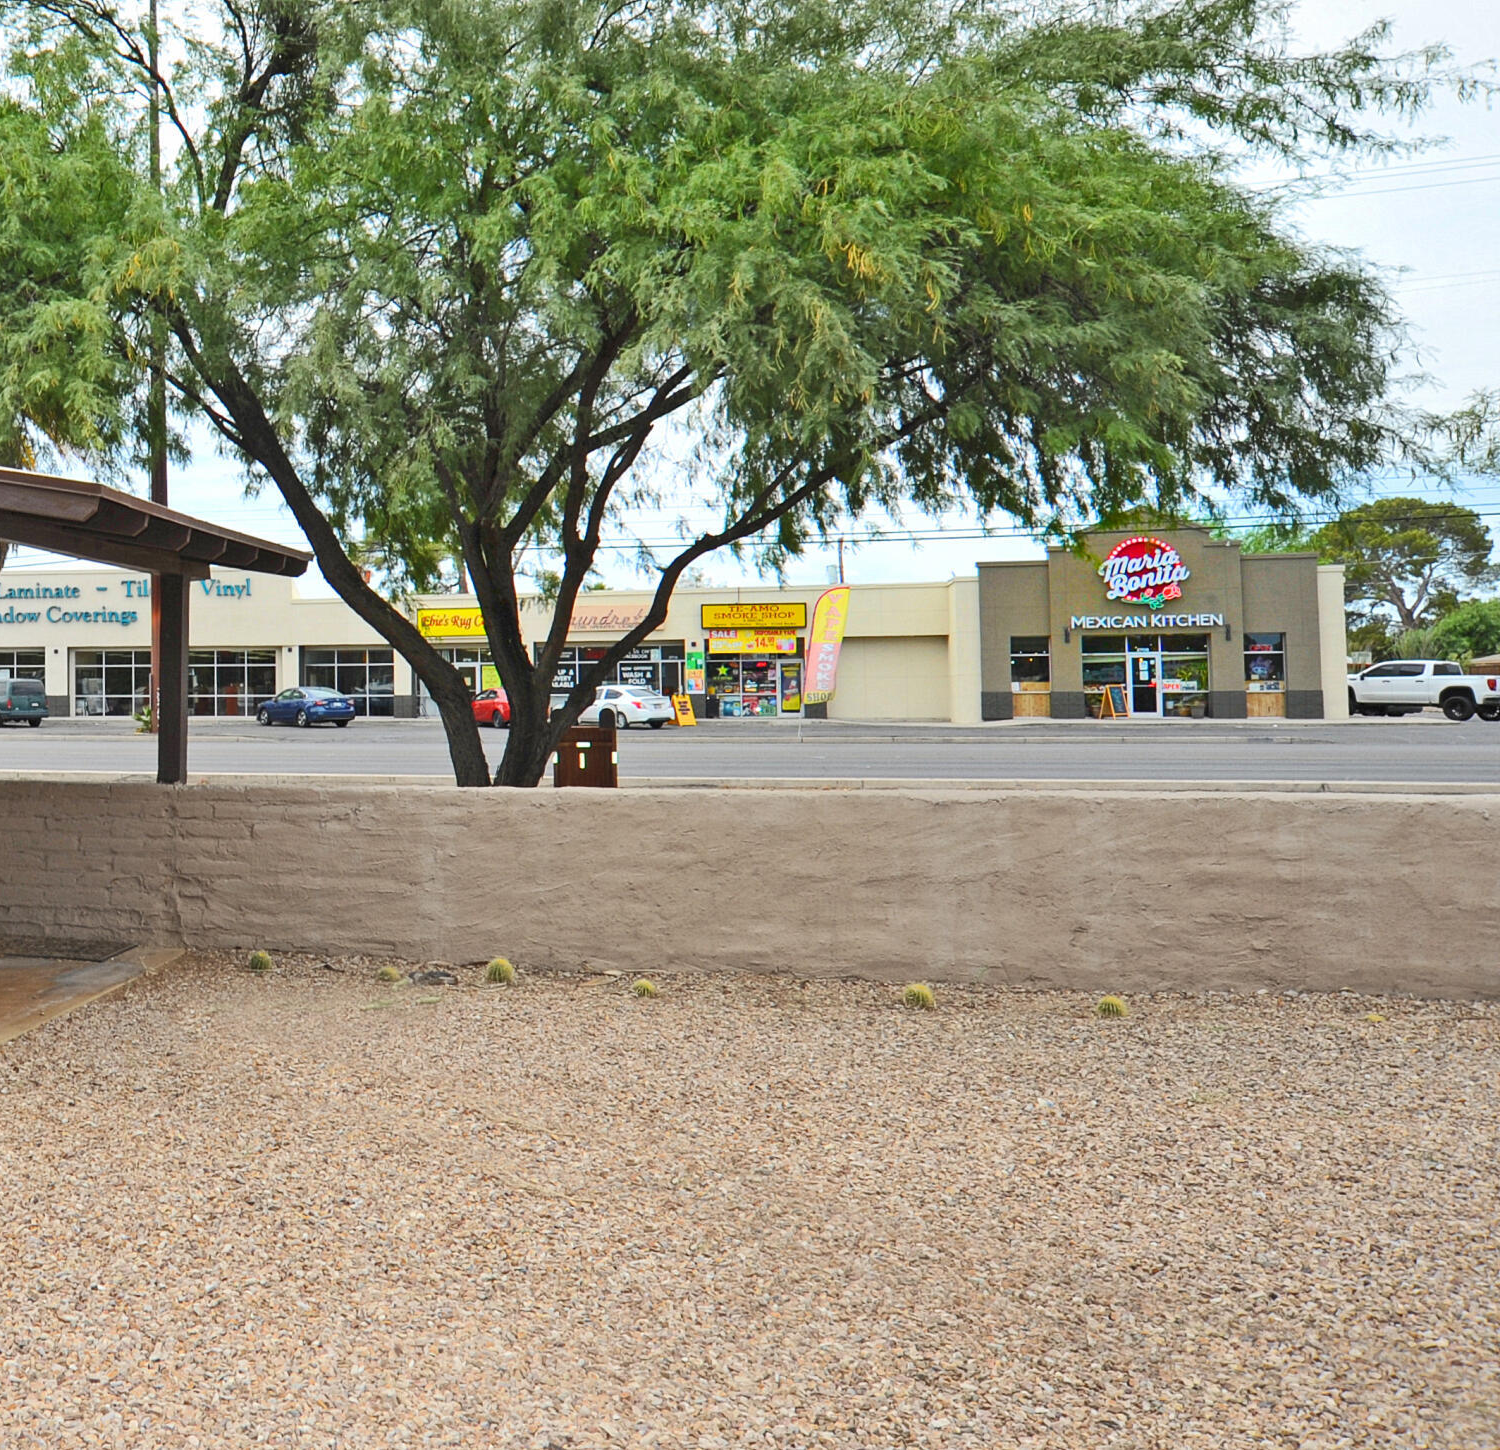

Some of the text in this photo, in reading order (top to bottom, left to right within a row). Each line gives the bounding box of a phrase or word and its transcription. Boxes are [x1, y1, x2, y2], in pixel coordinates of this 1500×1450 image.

[1097, 548, 1180, 583] Maria
[121, 579, 152, 598] Til
[200, 578, 252, 600] Vinyl
[1106, 564, 1190, 600] Bonita
[46, 605, 139, 626] Coverings
[713, 611, 795, 620] SMOKE SHOP
[729, 604, 780, 613] TE-AMO
[823, 593, 843, 641] VAPE
[451, 614, 472, 630] Rug
[1070, 613, 1224, 629] MEXICAN KITCHEN
[711, 630, 737, 639] SALE
[816, 643, 835, 690] SMOKE
